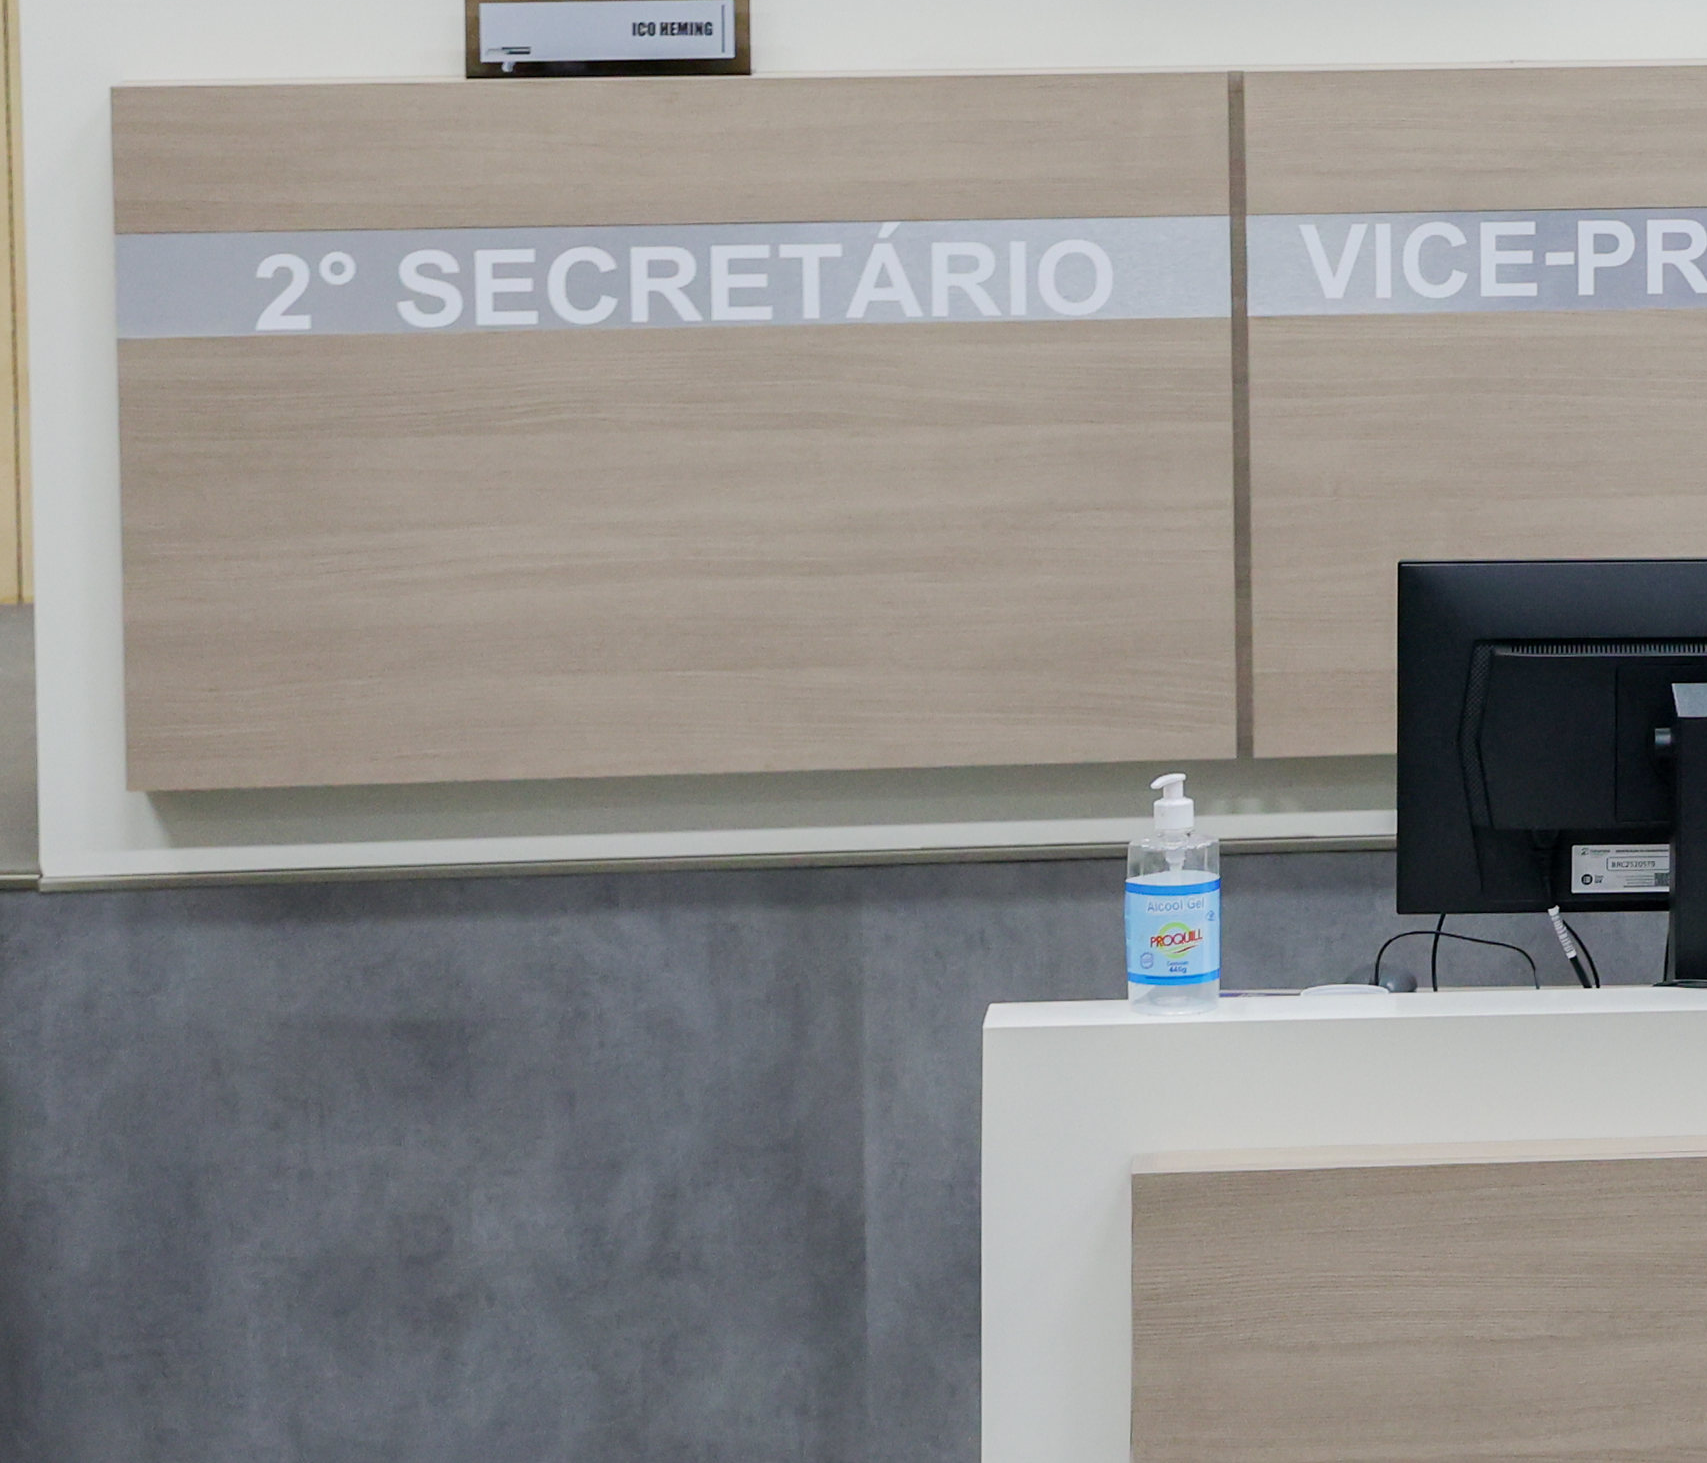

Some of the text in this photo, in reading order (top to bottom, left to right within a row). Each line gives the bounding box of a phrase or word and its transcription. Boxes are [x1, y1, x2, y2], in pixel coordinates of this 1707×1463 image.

[632, 21, 713, 37] ICO HEMING
[396, 221, 1115, 329] SECRETÁRIO
[1147, 897, 1205, 912] Alcool Gel
